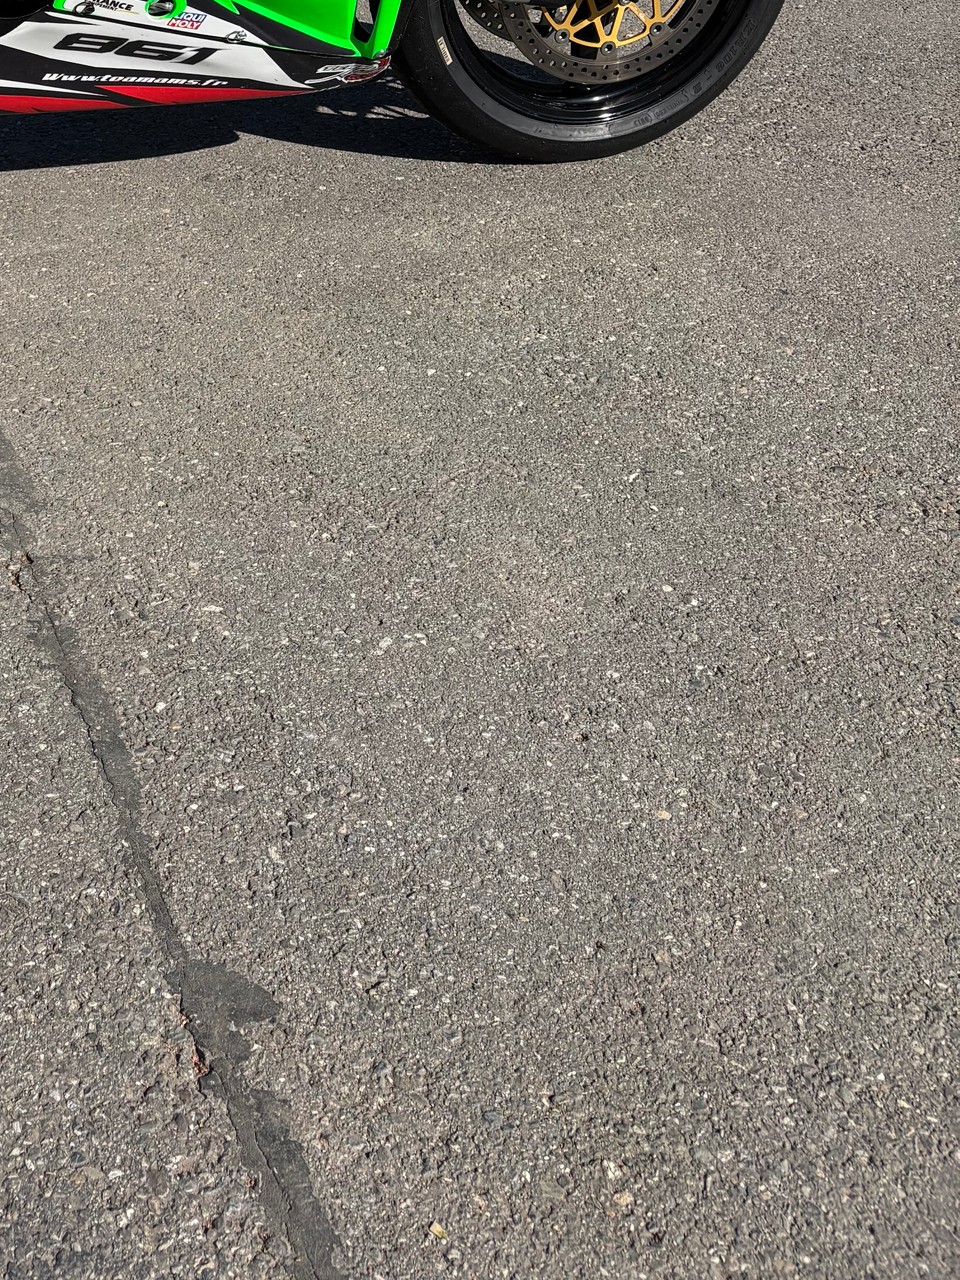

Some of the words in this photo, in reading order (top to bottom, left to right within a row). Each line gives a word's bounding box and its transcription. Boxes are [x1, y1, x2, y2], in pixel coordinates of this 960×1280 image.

[176, 12, 206, 22] IQUI
[168, 19, 200, 29] MOLY
[53, 32, 224, 66] 861
